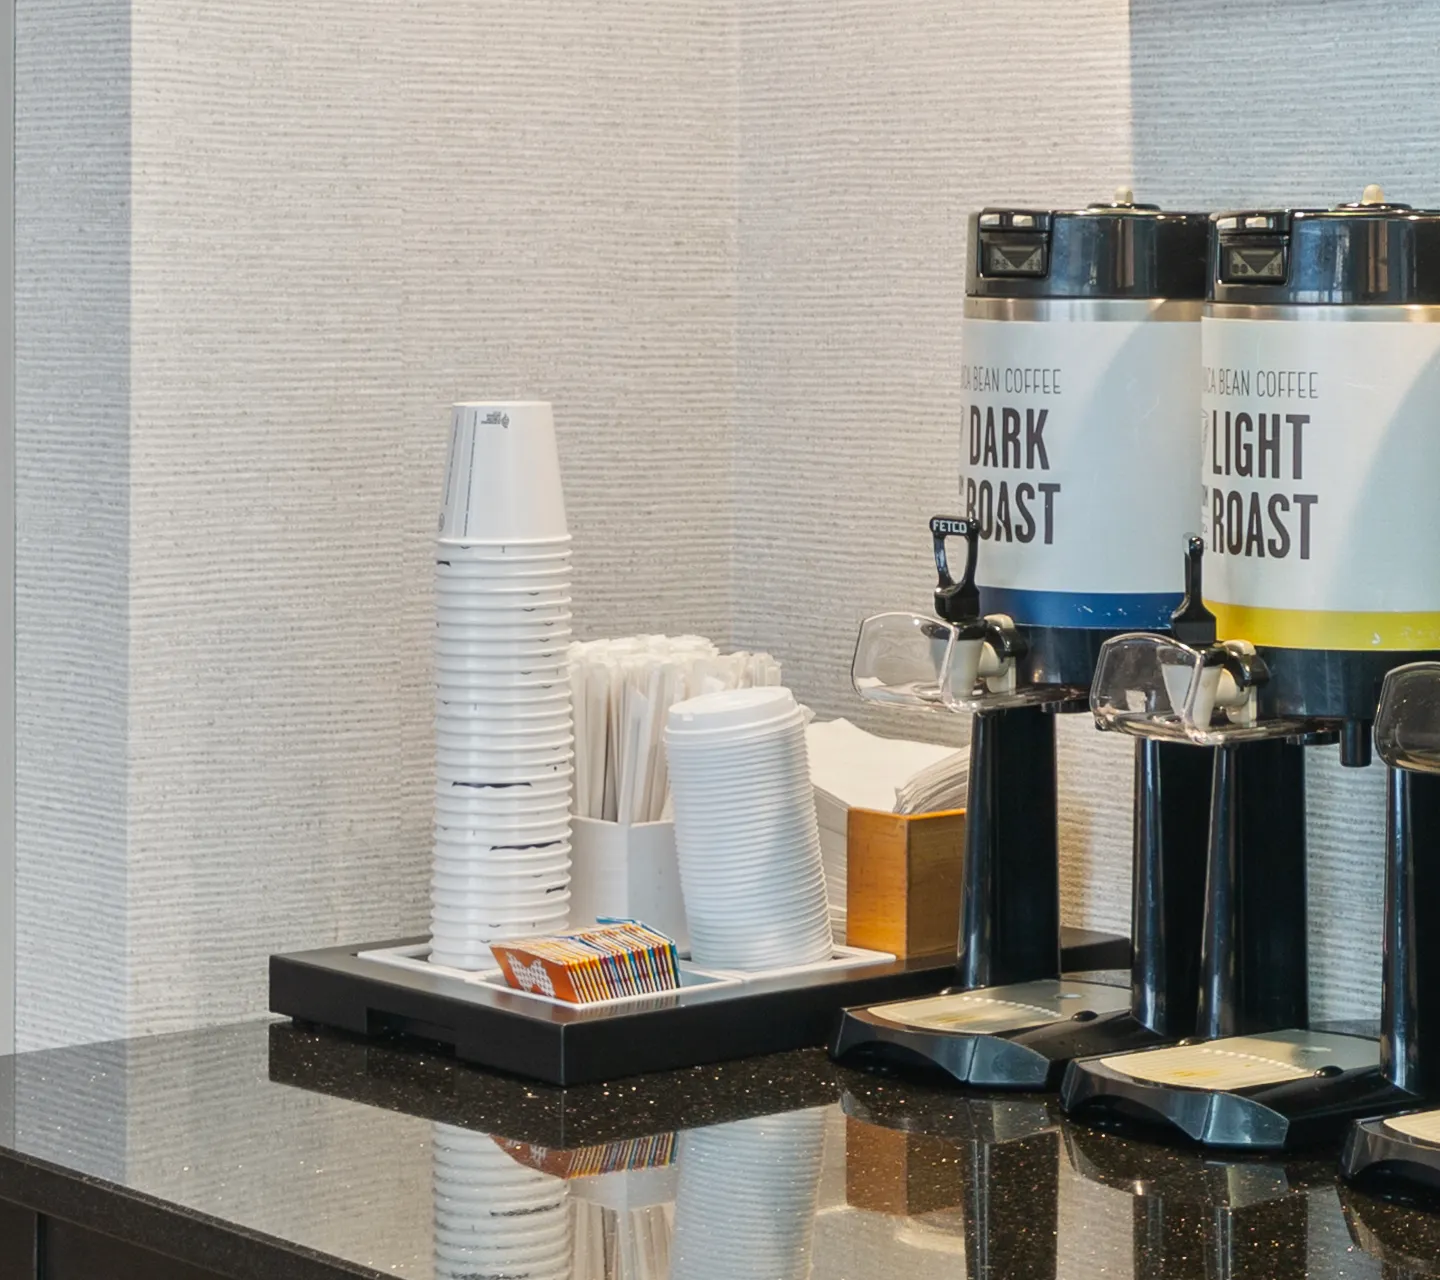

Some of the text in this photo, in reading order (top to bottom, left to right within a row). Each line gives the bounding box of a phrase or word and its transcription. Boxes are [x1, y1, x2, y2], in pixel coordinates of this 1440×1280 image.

[973, 366, 1000, 393] BEAN
[1005, 368, 1062, 394] COFFEE
[1219, 368, 1250, 397] BEAN
[1256, 370, 1319, 399] COFFEE
[969, 404, 1050, 470] DARK
[1212, 409, 1311, 480] LIGHT
[933, 519, 968, 534] FETCO
[966, 477, 1062, 545] ROAST
[1212, 487, 1319, 561] ROAST
